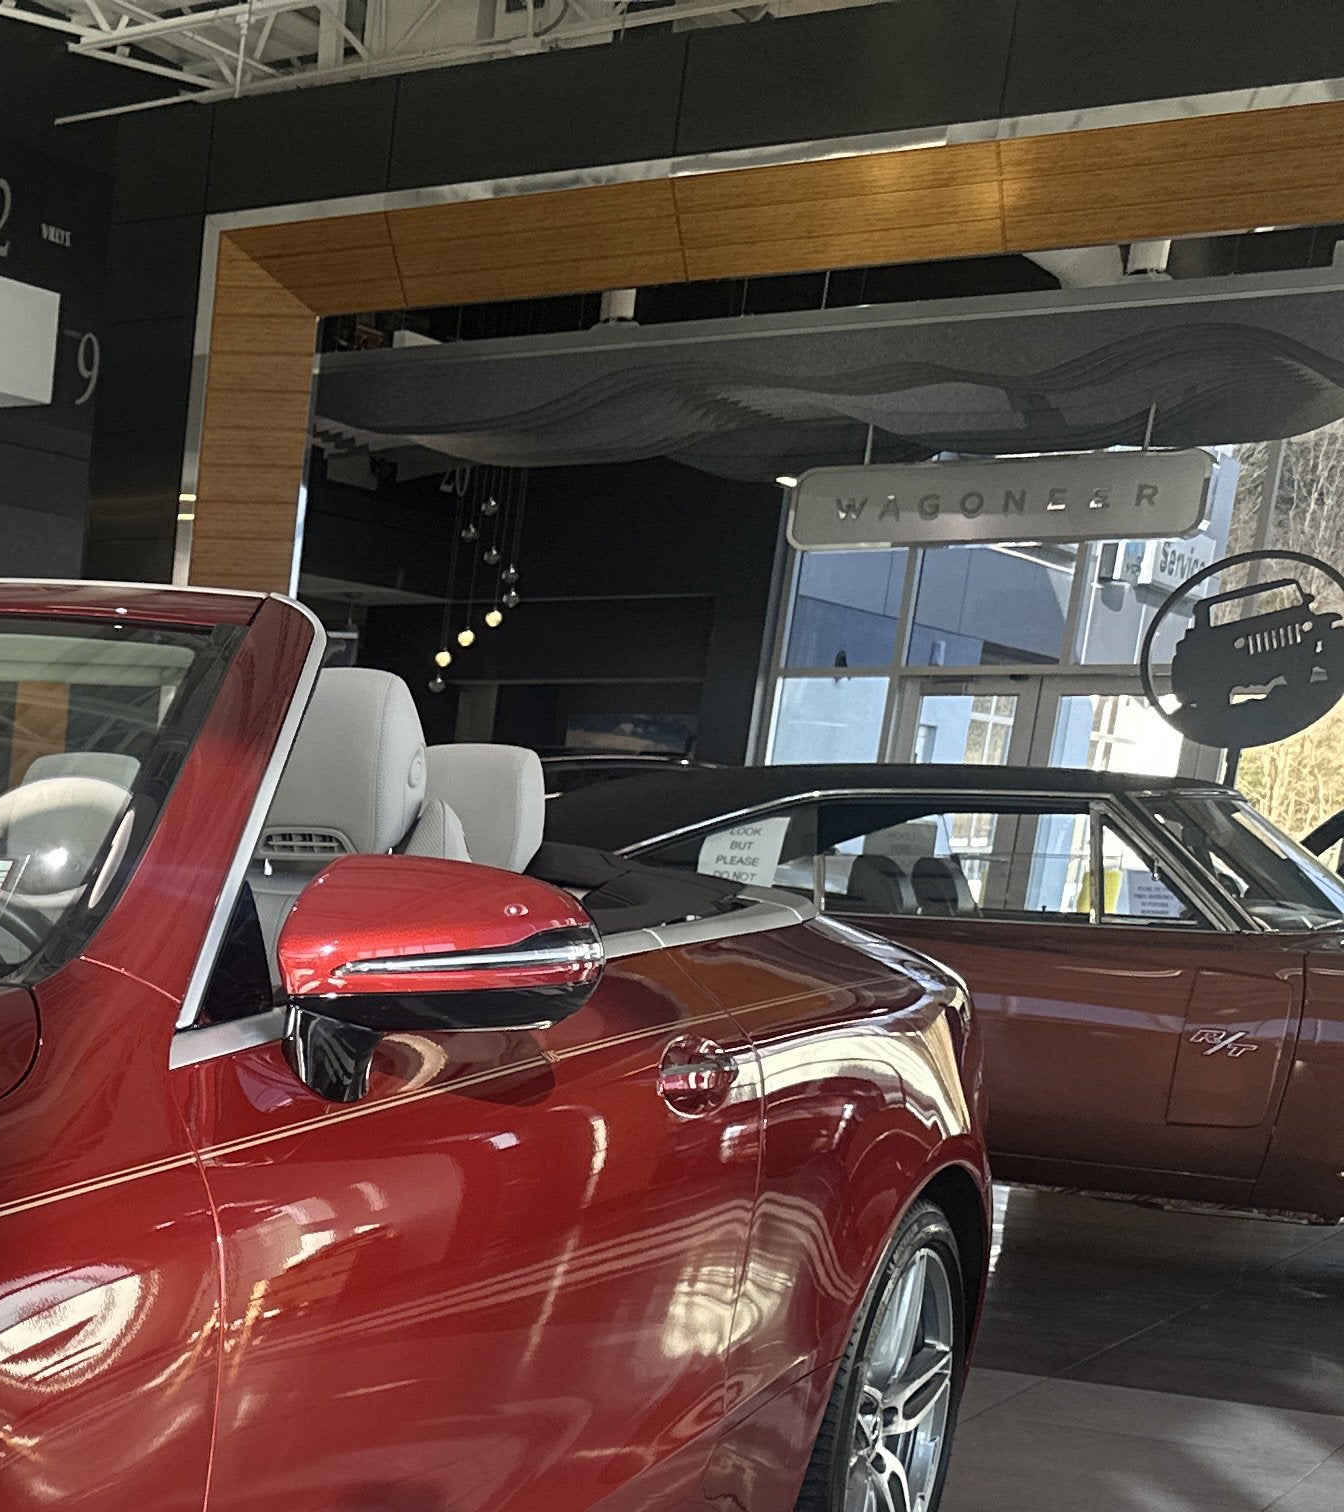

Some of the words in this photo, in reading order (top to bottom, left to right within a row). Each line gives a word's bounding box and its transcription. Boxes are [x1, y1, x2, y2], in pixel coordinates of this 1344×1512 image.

[836, 483, 1160, 521] WAGONEER
[729, 840, 755, 851] BUT
[715, 854, 760, 867] PLEASE
[731, 871, 757, 882] NOT
[1189, 1028, 1259, 1058] R/T
